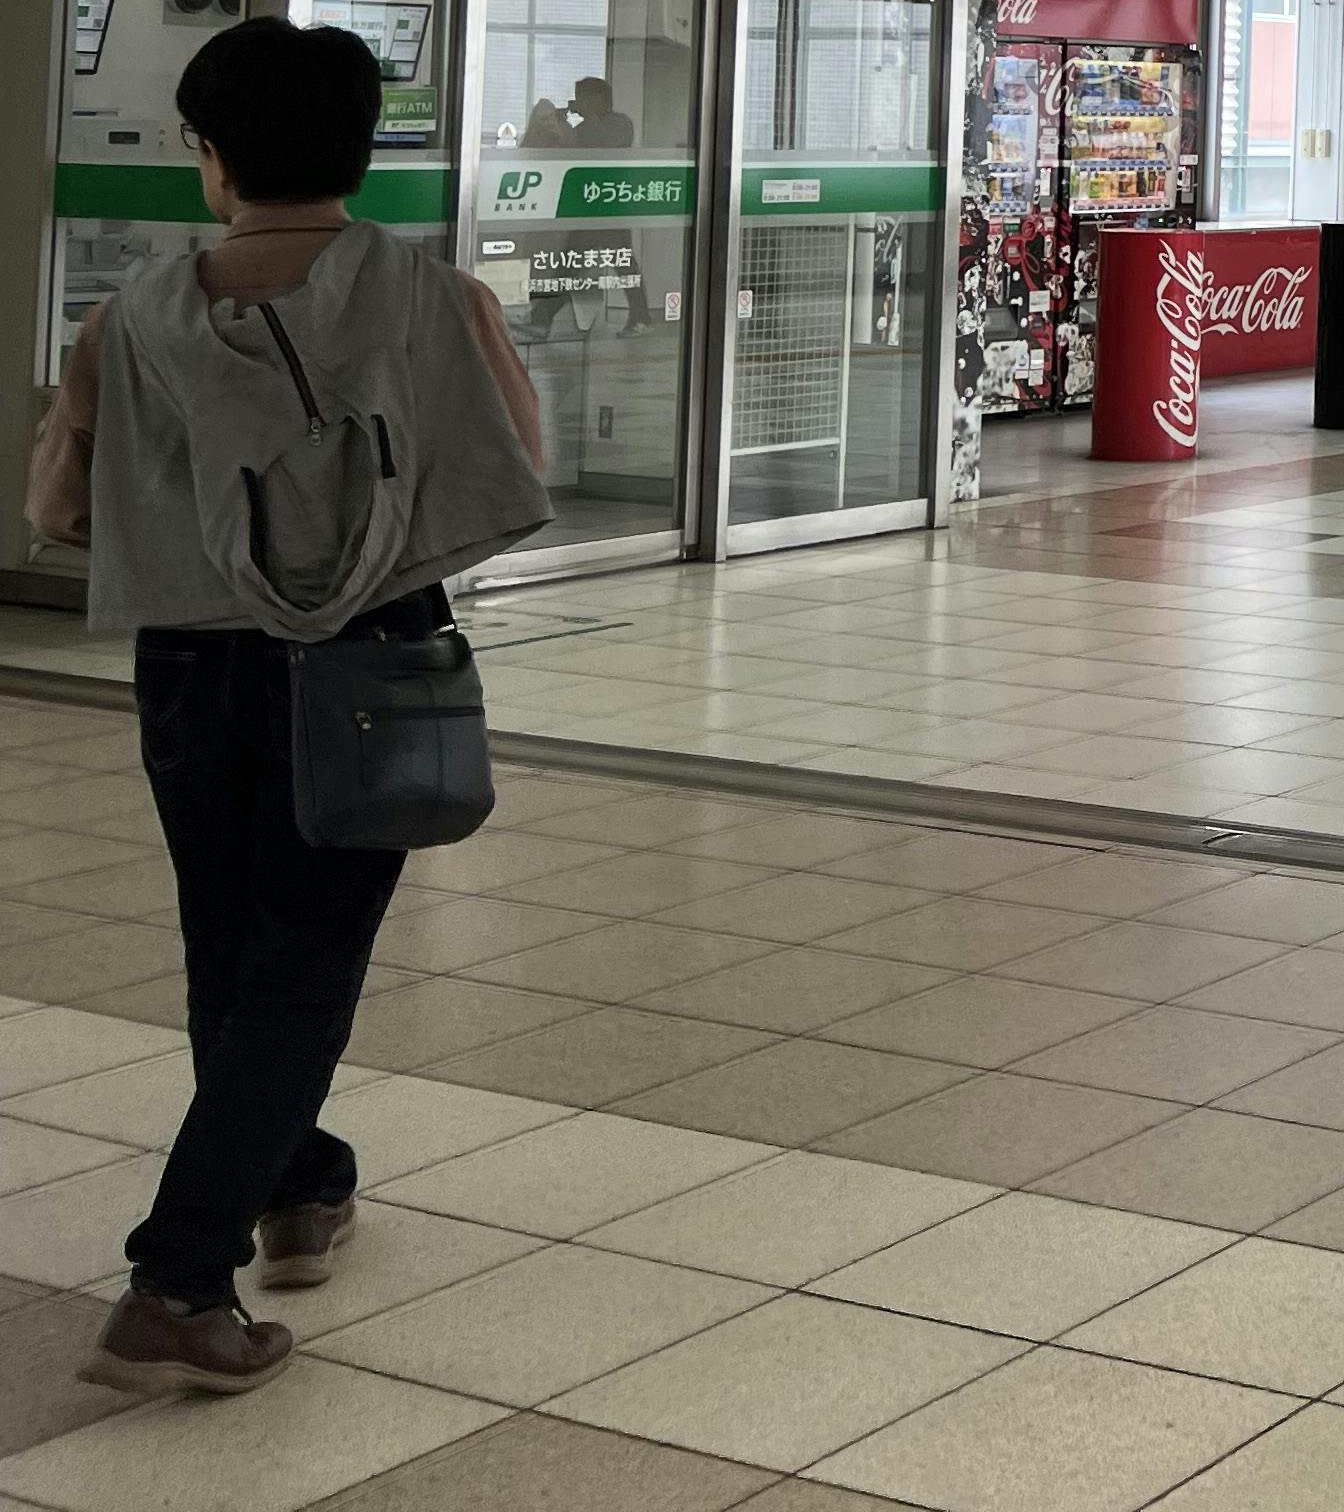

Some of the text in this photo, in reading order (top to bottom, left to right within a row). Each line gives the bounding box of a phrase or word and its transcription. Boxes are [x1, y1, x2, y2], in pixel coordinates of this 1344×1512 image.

[583, 181, 682, 203] ゆうちょ銀行
[494, 202, 538, 212] BANK
[533, 248, 632, 269] さいたま支店
[1153, 238, 1204, 448] Coca-Cola
